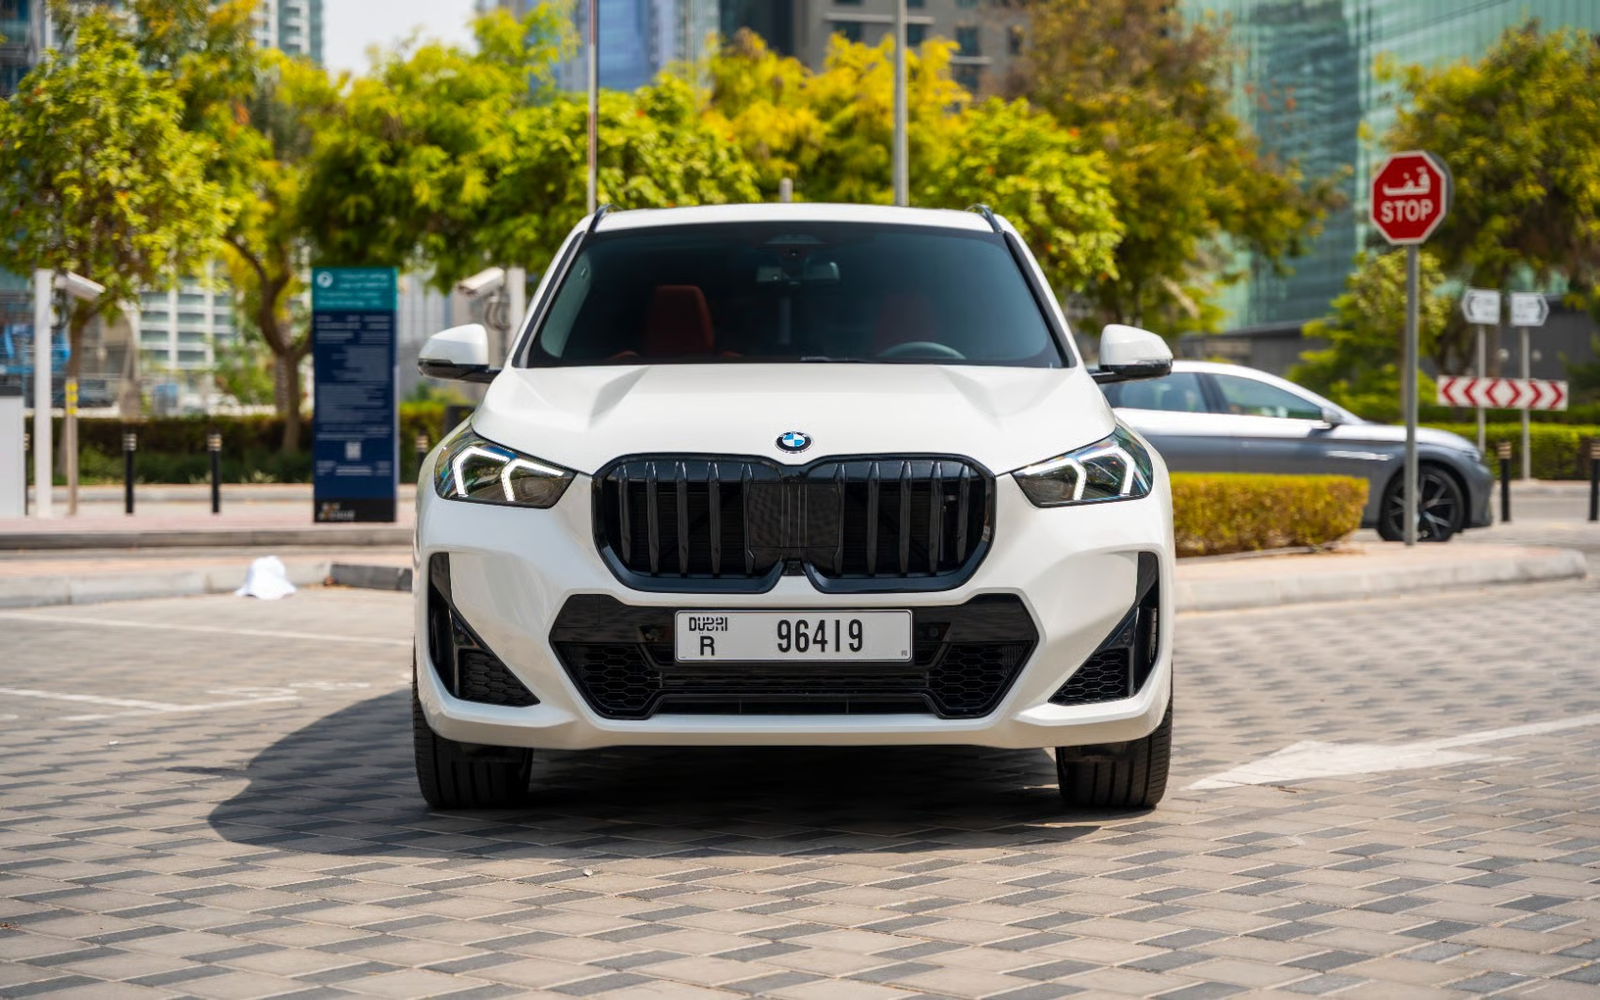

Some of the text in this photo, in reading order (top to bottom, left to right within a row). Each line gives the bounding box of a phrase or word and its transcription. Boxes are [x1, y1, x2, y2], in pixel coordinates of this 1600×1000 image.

[1382, 166, 1431, 195] قف
[1381, 199, 1433, 223] STOP
[688, 617, 728, 631] DUBAI
[777, 619, 863, 652] 96419
[700, 636, 715, 656] R
